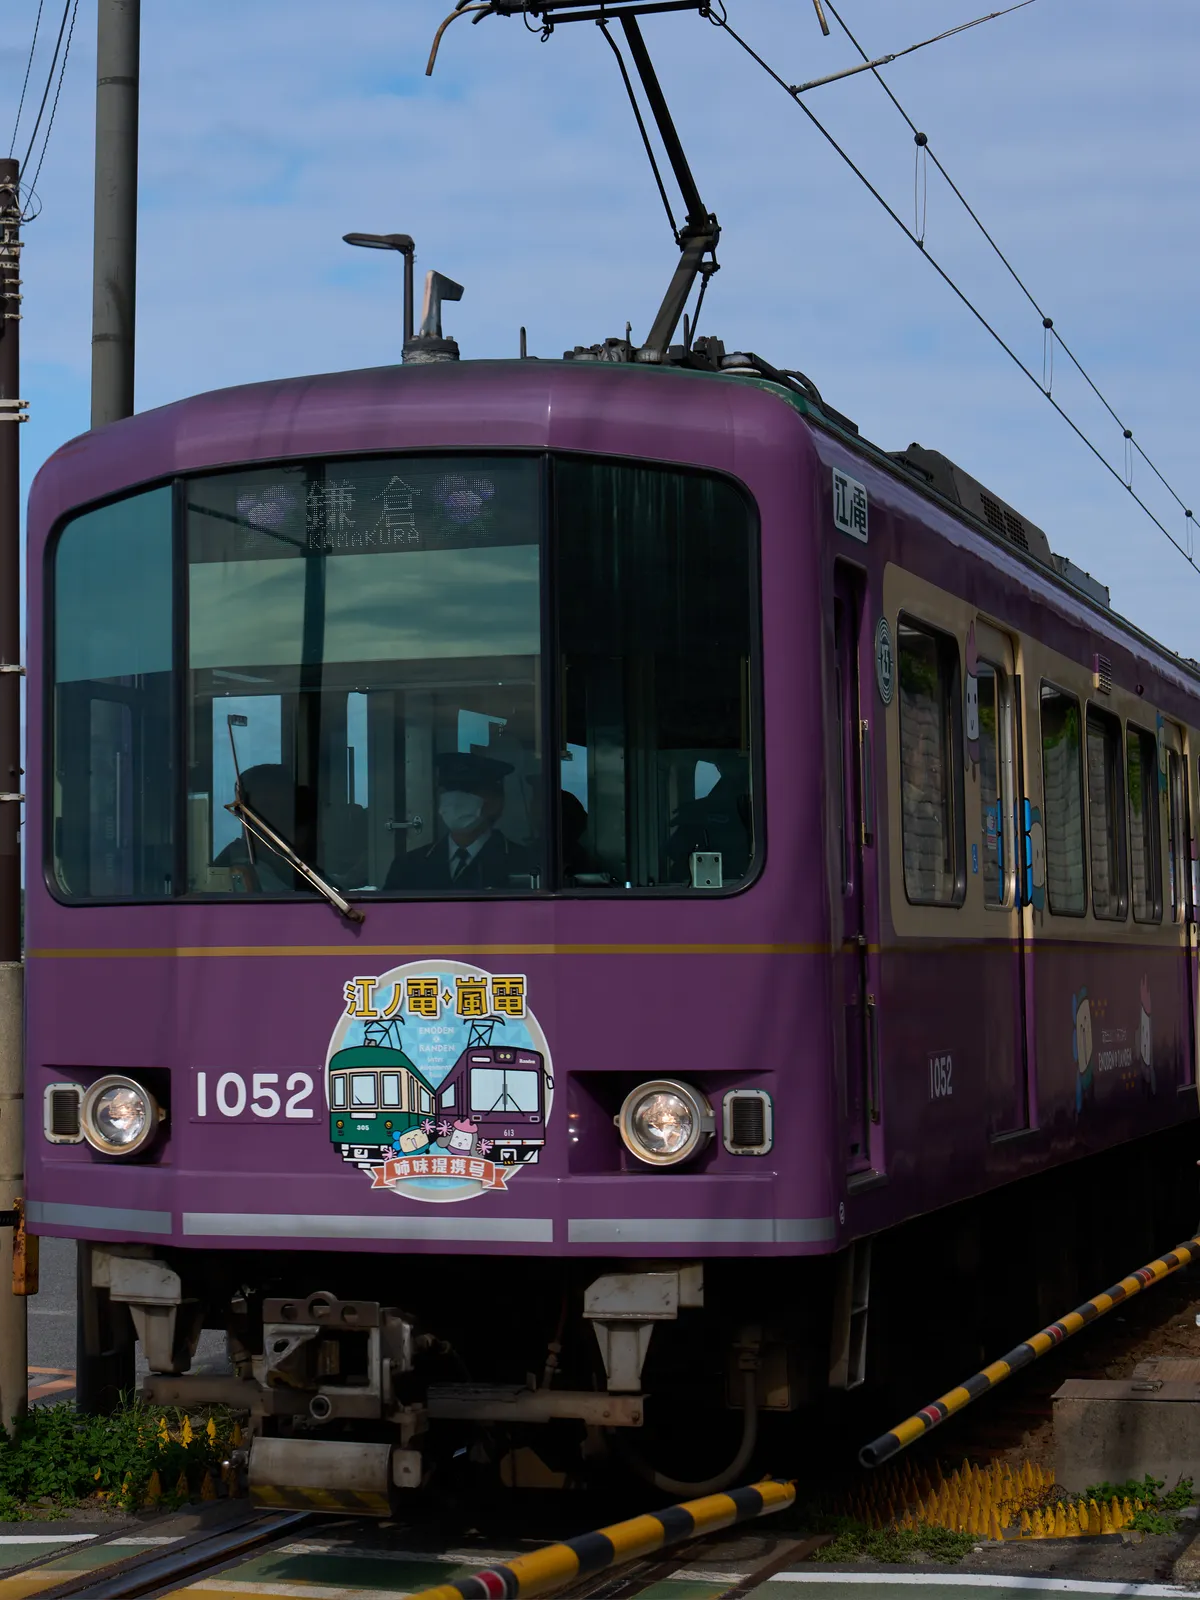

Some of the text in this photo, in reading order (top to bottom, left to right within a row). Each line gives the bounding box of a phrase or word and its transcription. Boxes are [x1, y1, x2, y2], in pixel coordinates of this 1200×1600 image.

[305, 475, 422, 530] 鎌倉
[309, 528, 420, 549] KAMAKURA
[419, 1044, 456, 1052] RANDEN
[930, 1055, 953, 1099] 1052
[197, 1072, 314, 1118] 1052
[503, 1129, 515, 1137] 613
[393, 1157, 486, 1178] 姉妹提携号
